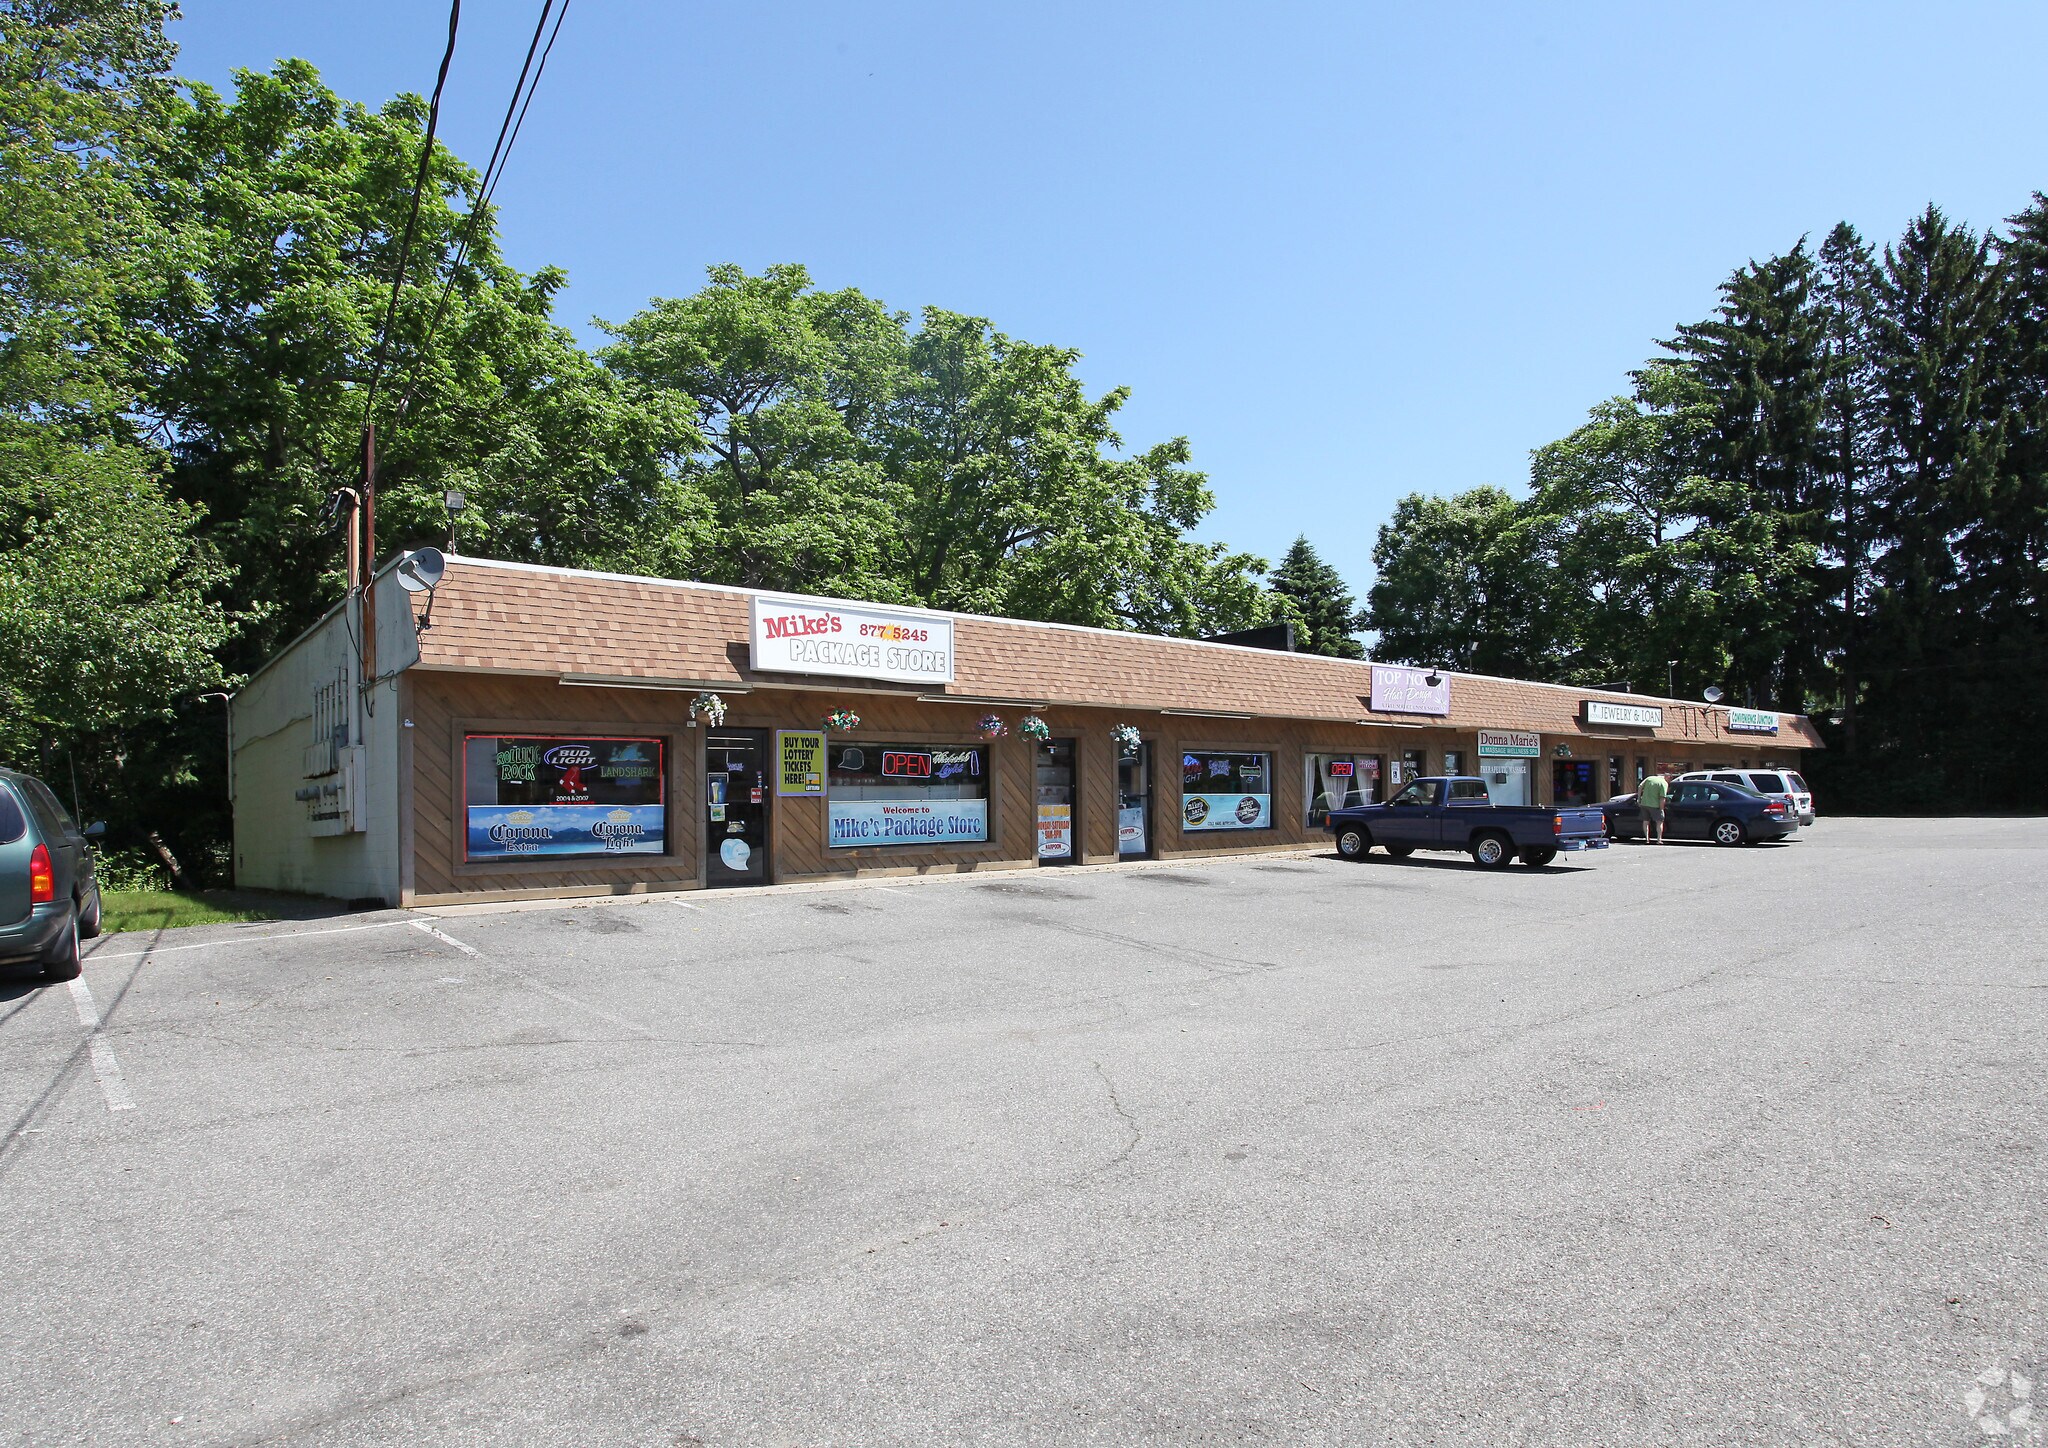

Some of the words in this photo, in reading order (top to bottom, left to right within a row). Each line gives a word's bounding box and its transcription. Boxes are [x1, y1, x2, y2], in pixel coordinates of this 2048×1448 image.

[763, 613, 842, 639] Mike's
[860, 623, 886, 637] 877
[893, 628, 928, 641] 5245
[790, 639, 880, 667] PACKAGE
[887, 647, 945, 672] STORE
[1376, 670, 1401, 685] TOP
[1383, 687, 1403, 701] Hair
[1406, 687, 1433, 703] Design
[1601, 707, 1632, 721] JEWELRY
[1634, 710, 1640, 721] &
[1641, 710, 1660, 723] LOAN
[784, 737, 799, 748] BUY
[800, 737, 819, 748] YOUR
[1480, 733, 1508, 745] Donna
[1510, 734, 1538, 746] Marie's
[496, 746, 541, 765] ROLLING
[784, 749, 814, 760] LOTTERY
[502, 764, 536, 781] ROCK
[784, 762, 811, 772] TICKETS
[884, 754, 930, 776] OPEN
[1331, 763, 1351, 775] OPEN
[784, 773, 804, 784] HERE!
[883, 806, 919, 814] Welcome
[489, 823, 552, 843] Corona
[591, 820, 645, 838] Corona
[834, 818, 880, 837] Mike's
[885, 816, 943, 837] Package
[948, 815, 980, 834] Store
[505, 840, 539, 852] Extra
[605, 836, 636, 850] Light
